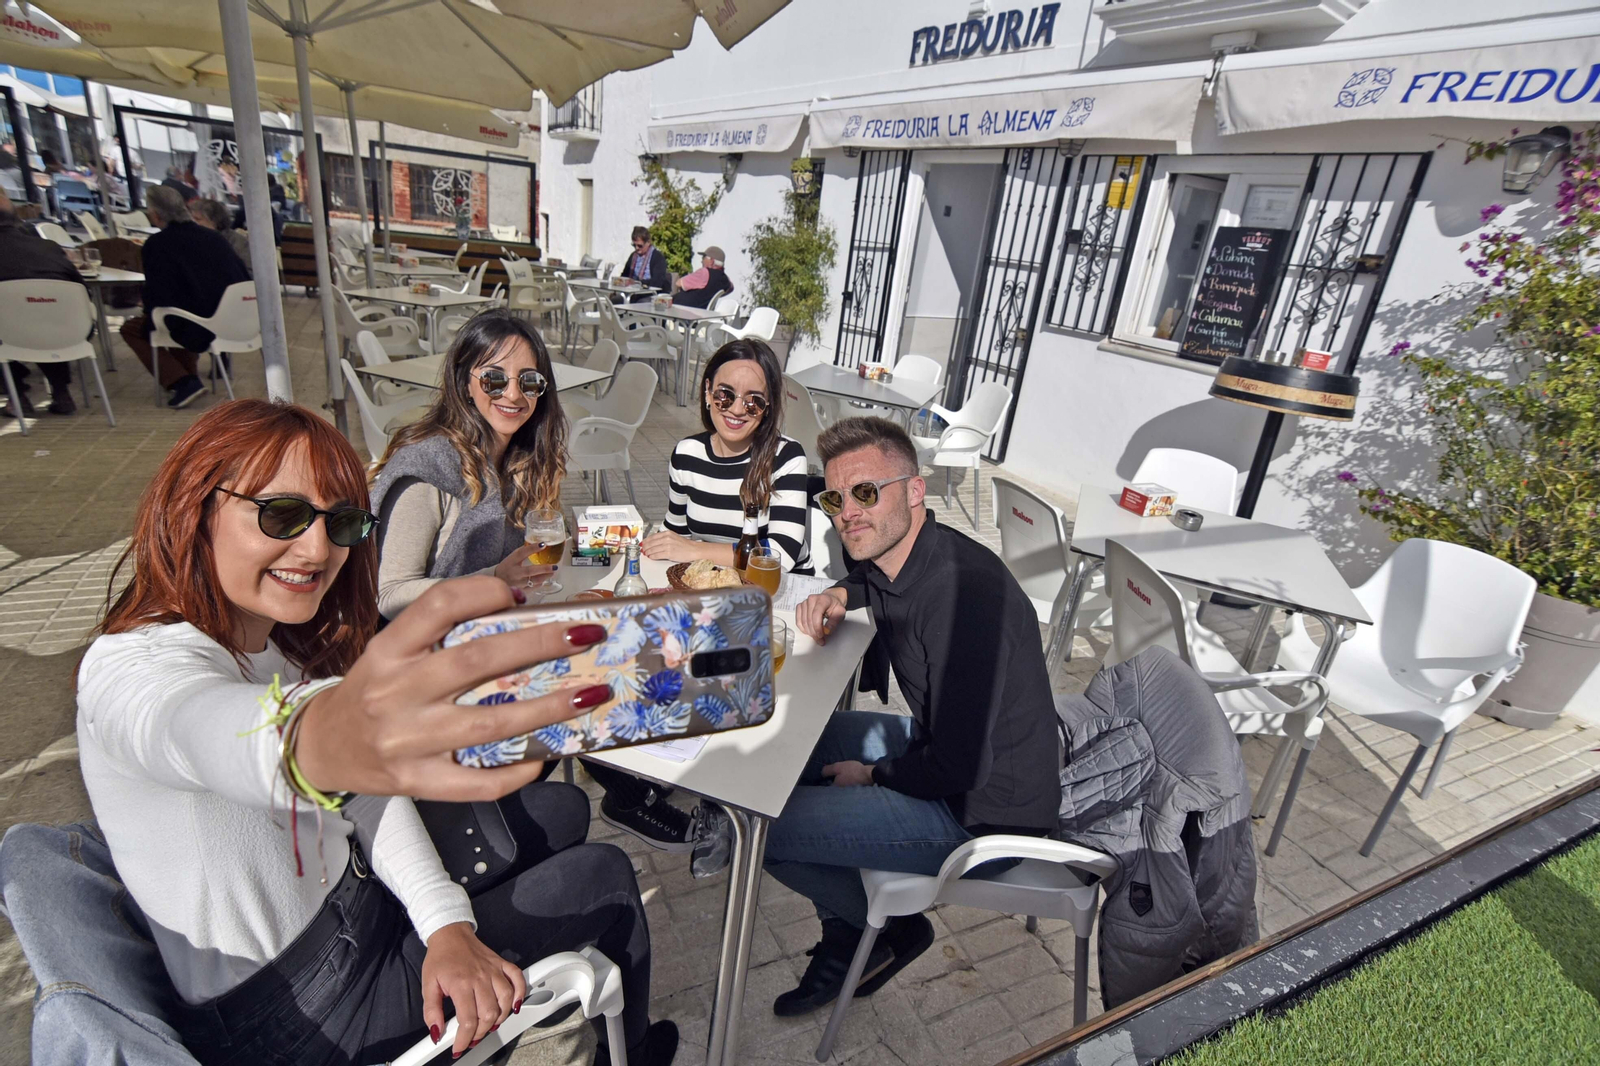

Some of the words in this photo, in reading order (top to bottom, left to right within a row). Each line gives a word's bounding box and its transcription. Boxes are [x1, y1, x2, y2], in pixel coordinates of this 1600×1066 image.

[909, 2, 1062, 67] FREIDURIA
[1399, 63, 1600, 103] FREIDU
[479, 126, 508, 138] Mahou
[862, 115, 939, 139] FREIDURIA
[949, 113, 969, 136] LA
[977, 109, 1057, 136] ALMENA
[710, 132, 720, 147] LA
[1012, 506, 1034, 526] Mahou
[1127, 577, 1152, 606] Mahou
